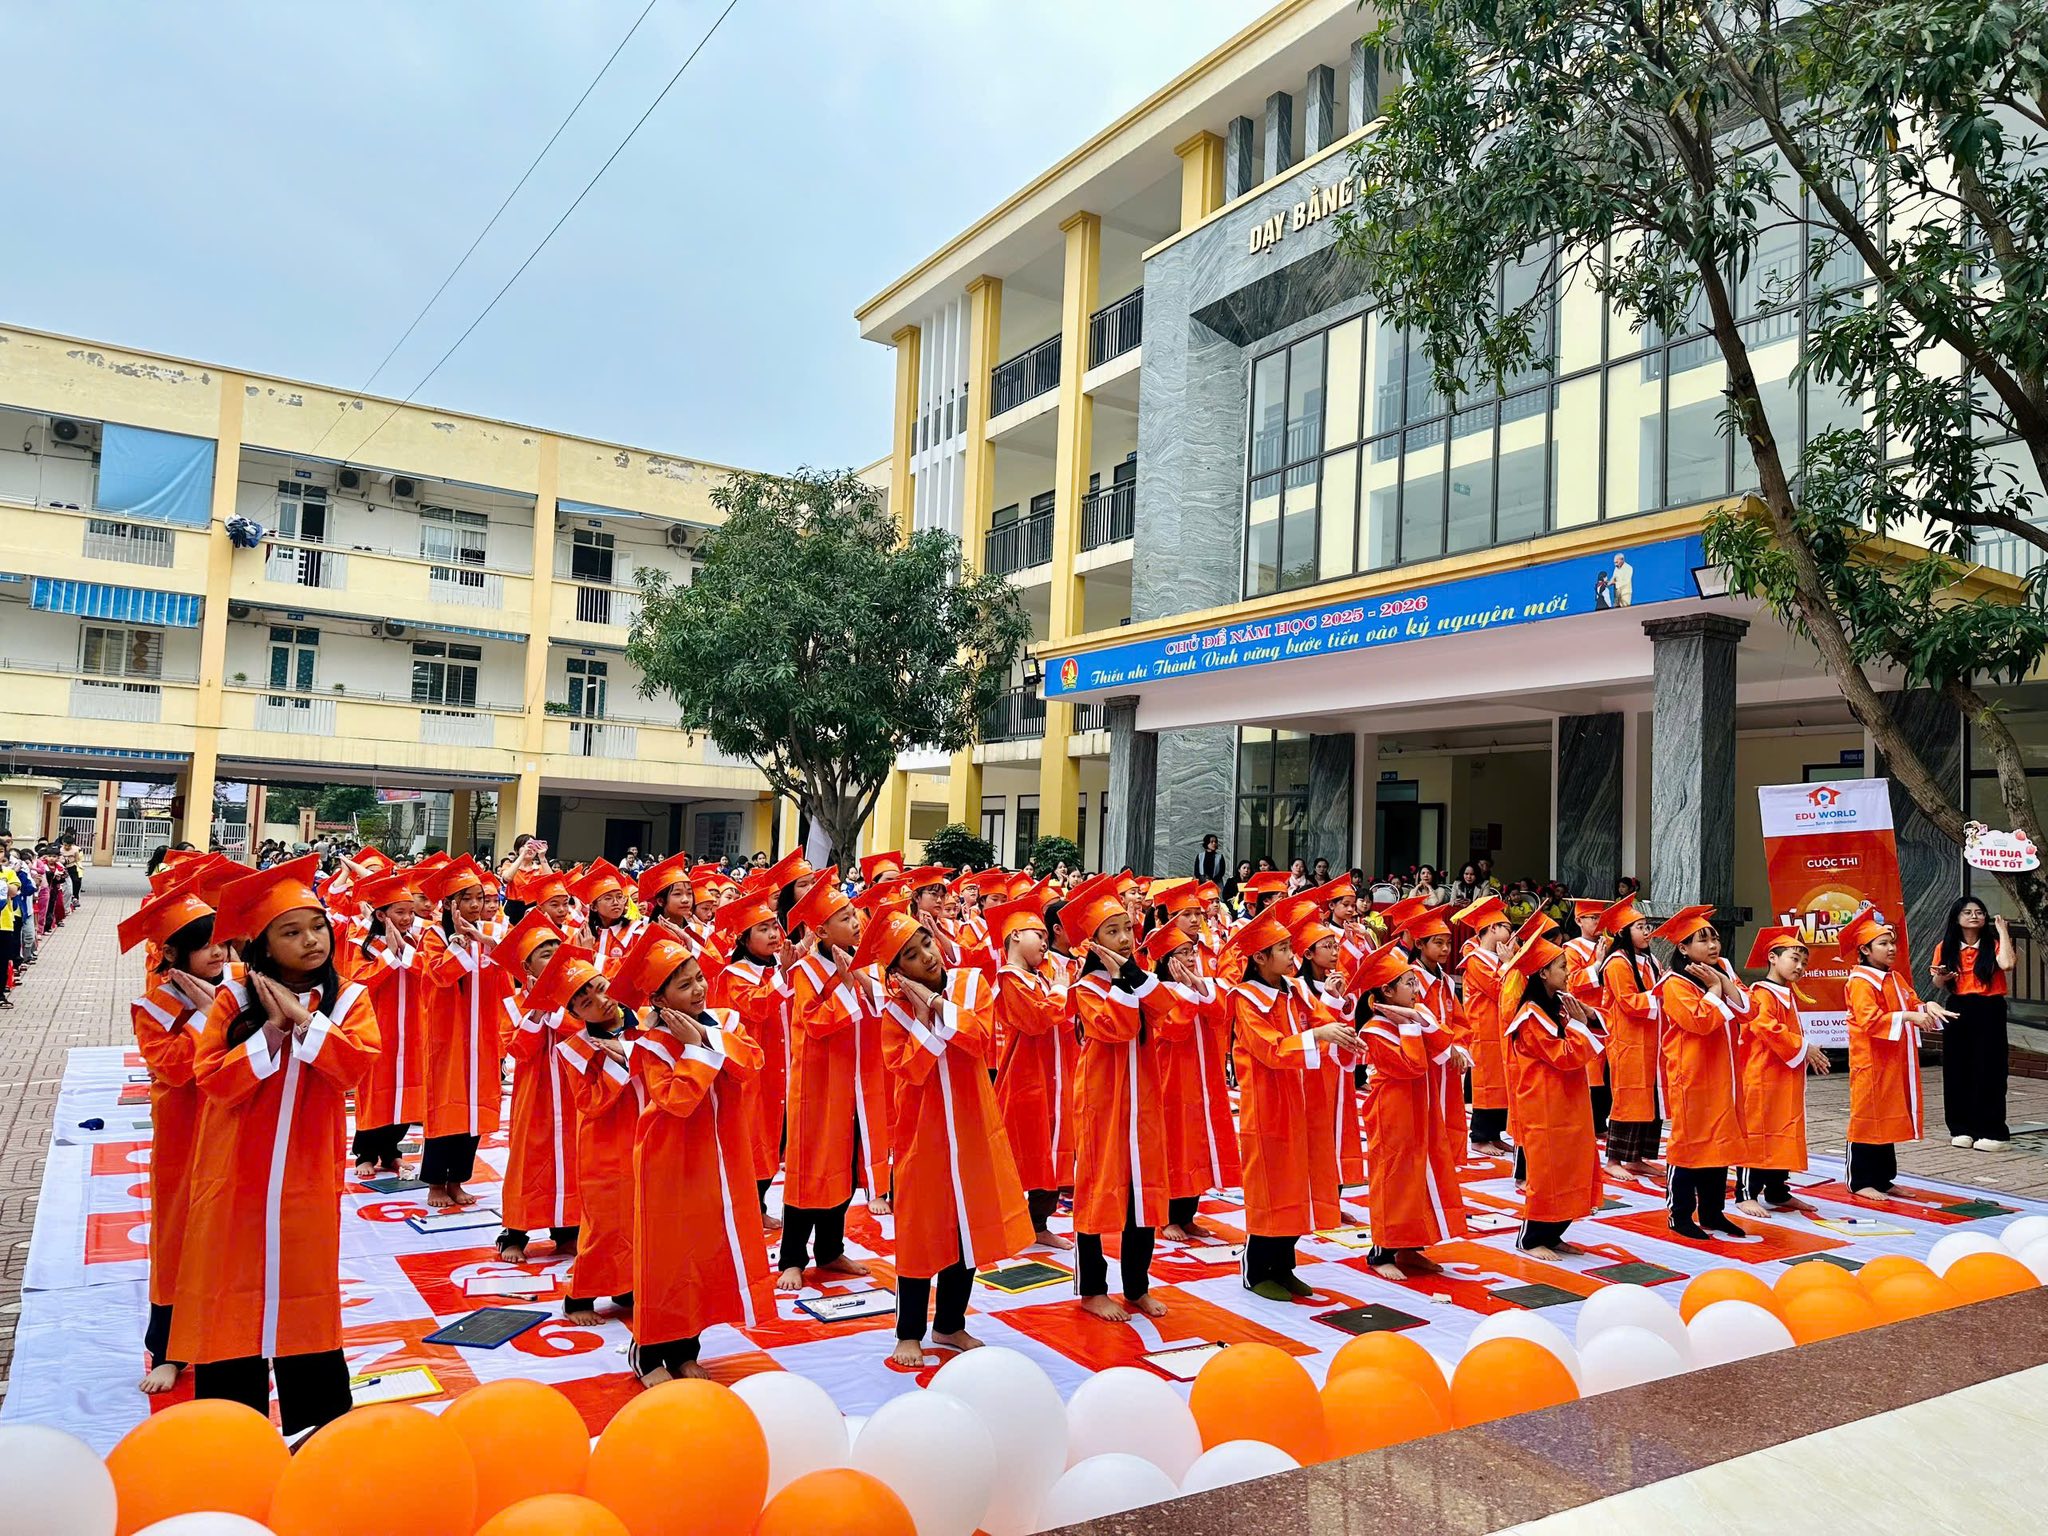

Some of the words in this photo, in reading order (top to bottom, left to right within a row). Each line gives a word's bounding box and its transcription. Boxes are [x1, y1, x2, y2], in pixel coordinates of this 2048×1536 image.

[1250, 211, 1286, 255] DẠY
[1165, 634, 1200, 656] CHỦ
[1202, 627, 1227, 650] ĐỀ
[1229, 624, 1271, 645] NĂM
[1275, 616, 1317, 637] HỌC
[1321, 607, 1364, 628] 2025
[1380, 596, 1428, 617] 2026
[1127, 664, 1148, 680] nhi
[1153, 656, 1197, 676] Thành
[1201, 648, 1238, 667] Vinh
[1243, 645, 1281, 662] vững
[1285, 636, 1322, 655] bước
[1327, 629, 1360, 649] tiến
[1366, 624, 1398, 642] vào
[1405, 615, 1431, 637] kỷ
[1437, 605, 1516, 633] nguyên
[1523, 593, 1570, 617] mới
[1819, 810, 1857, 818] WORLD
[1980, 849, 1996, 857] THI
[1999, 850, 2022, 858] ĐUA
[1807, 857, 1838, 868] CUỘC
[1840, 857, 1858, 866] THI
[1980, 859, 2000, 868] HỌC
[2002, 859, 2023, 868] TỐT
[1827, 969, 1849, 977] BINH
